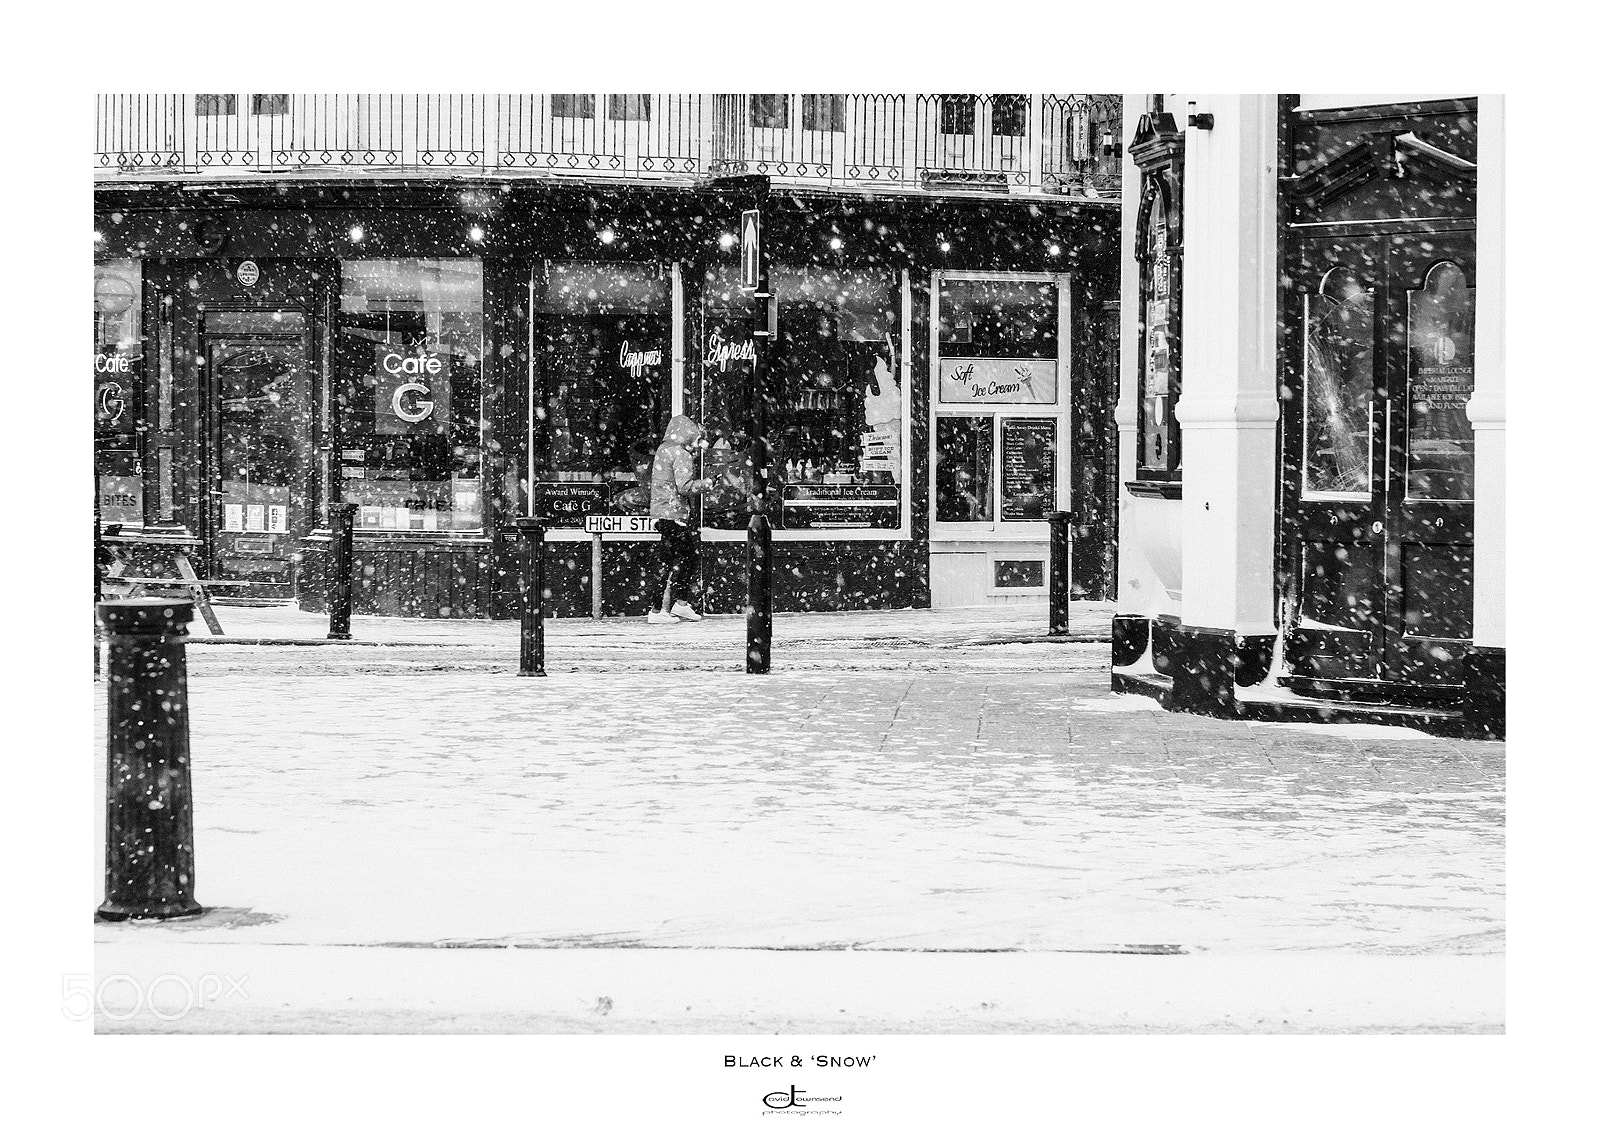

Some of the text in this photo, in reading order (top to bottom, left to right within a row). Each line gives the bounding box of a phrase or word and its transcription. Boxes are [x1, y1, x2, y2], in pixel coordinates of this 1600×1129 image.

[95, 353, 129, 373] Café
[383, 353, 442, 374] Café
[951, 364, 974, 385] Soft
[972, 381, 1020, 397] Ice Cream
[392, 383, 434, 423] G
[545, 488, 569, 496] Award
[805, 488, 878, 497] Traditional Ice Cream
[104, 495, 137, 507] BITES
[554, 500, 591, 512] Café G
[588, 517, 622, 531] HIGH
